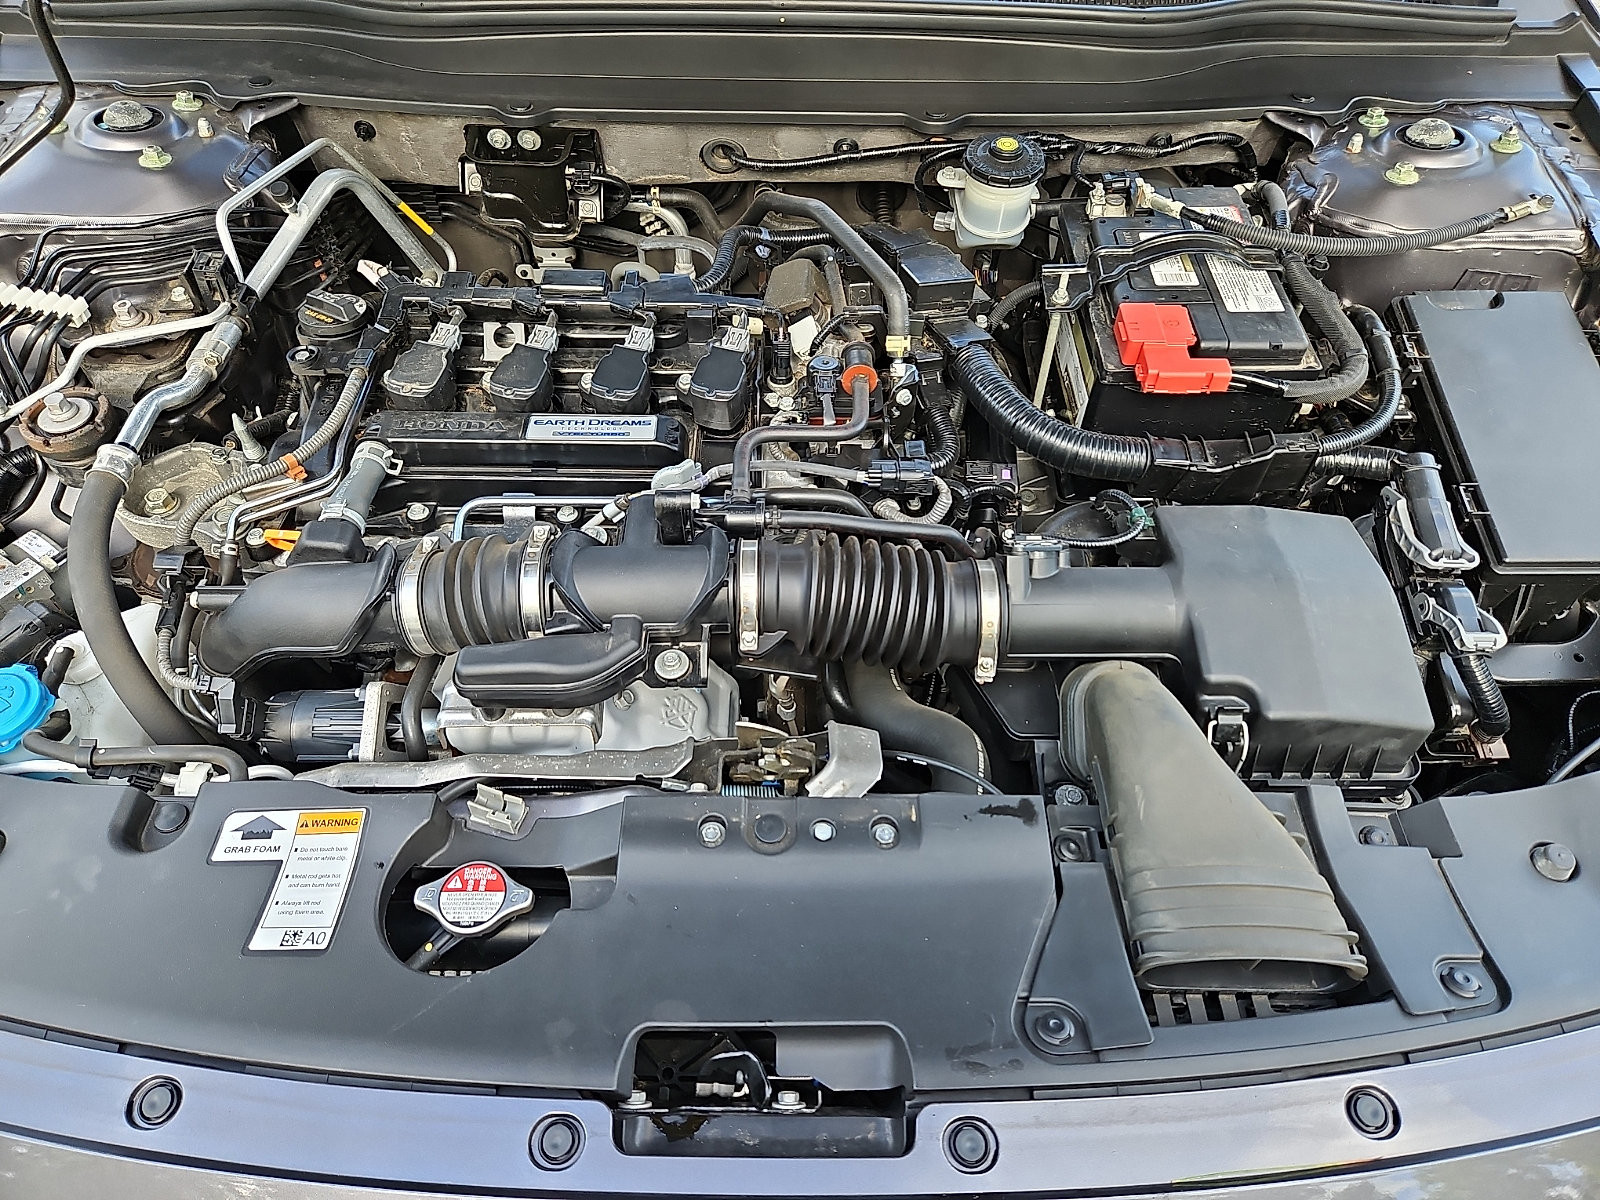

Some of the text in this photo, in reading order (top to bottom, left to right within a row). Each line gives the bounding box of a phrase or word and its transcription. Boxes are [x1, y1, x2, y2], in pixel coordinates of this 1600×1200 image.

[394, 419, 509, 432] HONDA
[311, 818, 359, 828] WARNING
[223, 845, 282, 854] GRAB FOAM
[303, 931, 327, 945] A0
